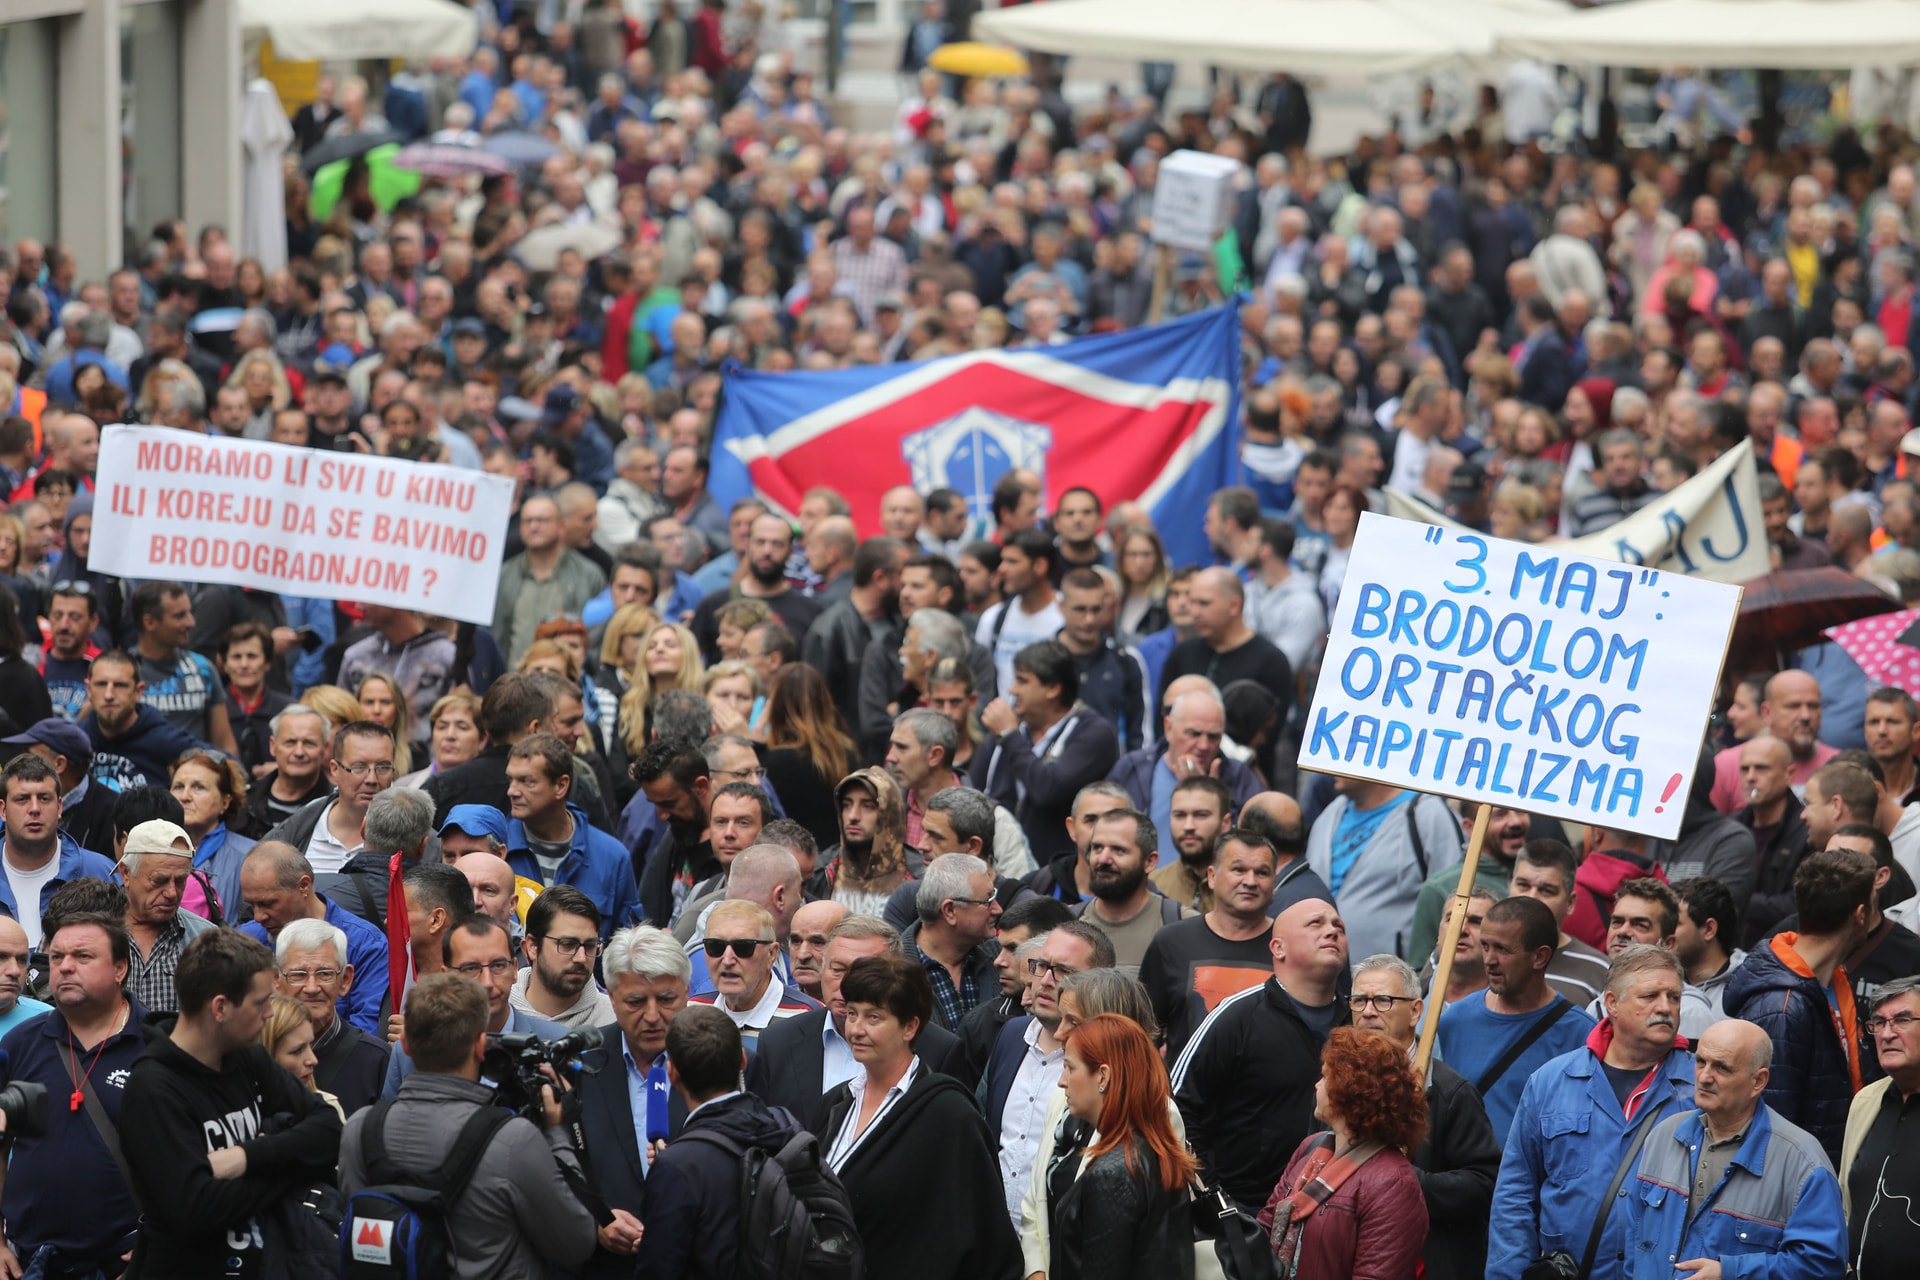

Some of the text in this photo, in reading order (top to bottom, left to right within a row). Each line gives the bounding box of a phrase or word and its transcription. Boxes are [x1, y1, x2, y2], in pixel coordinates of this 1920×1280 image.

[137, 441, 475, 512] MORAMO LI SVI U KINU
[111, 484, 487, 561] ILI KOREJU DA SE BAVIMO
[1614, 469, 1748, 572] AJ
[149, 535, 438, 597] BRODOGRADNJOM ?
[1351, 583, 1649, 692] BRODOLOM
[1341, 646, 1642, 762] ORTAČKOG
[572, 1122, 585, 1150] SONY
